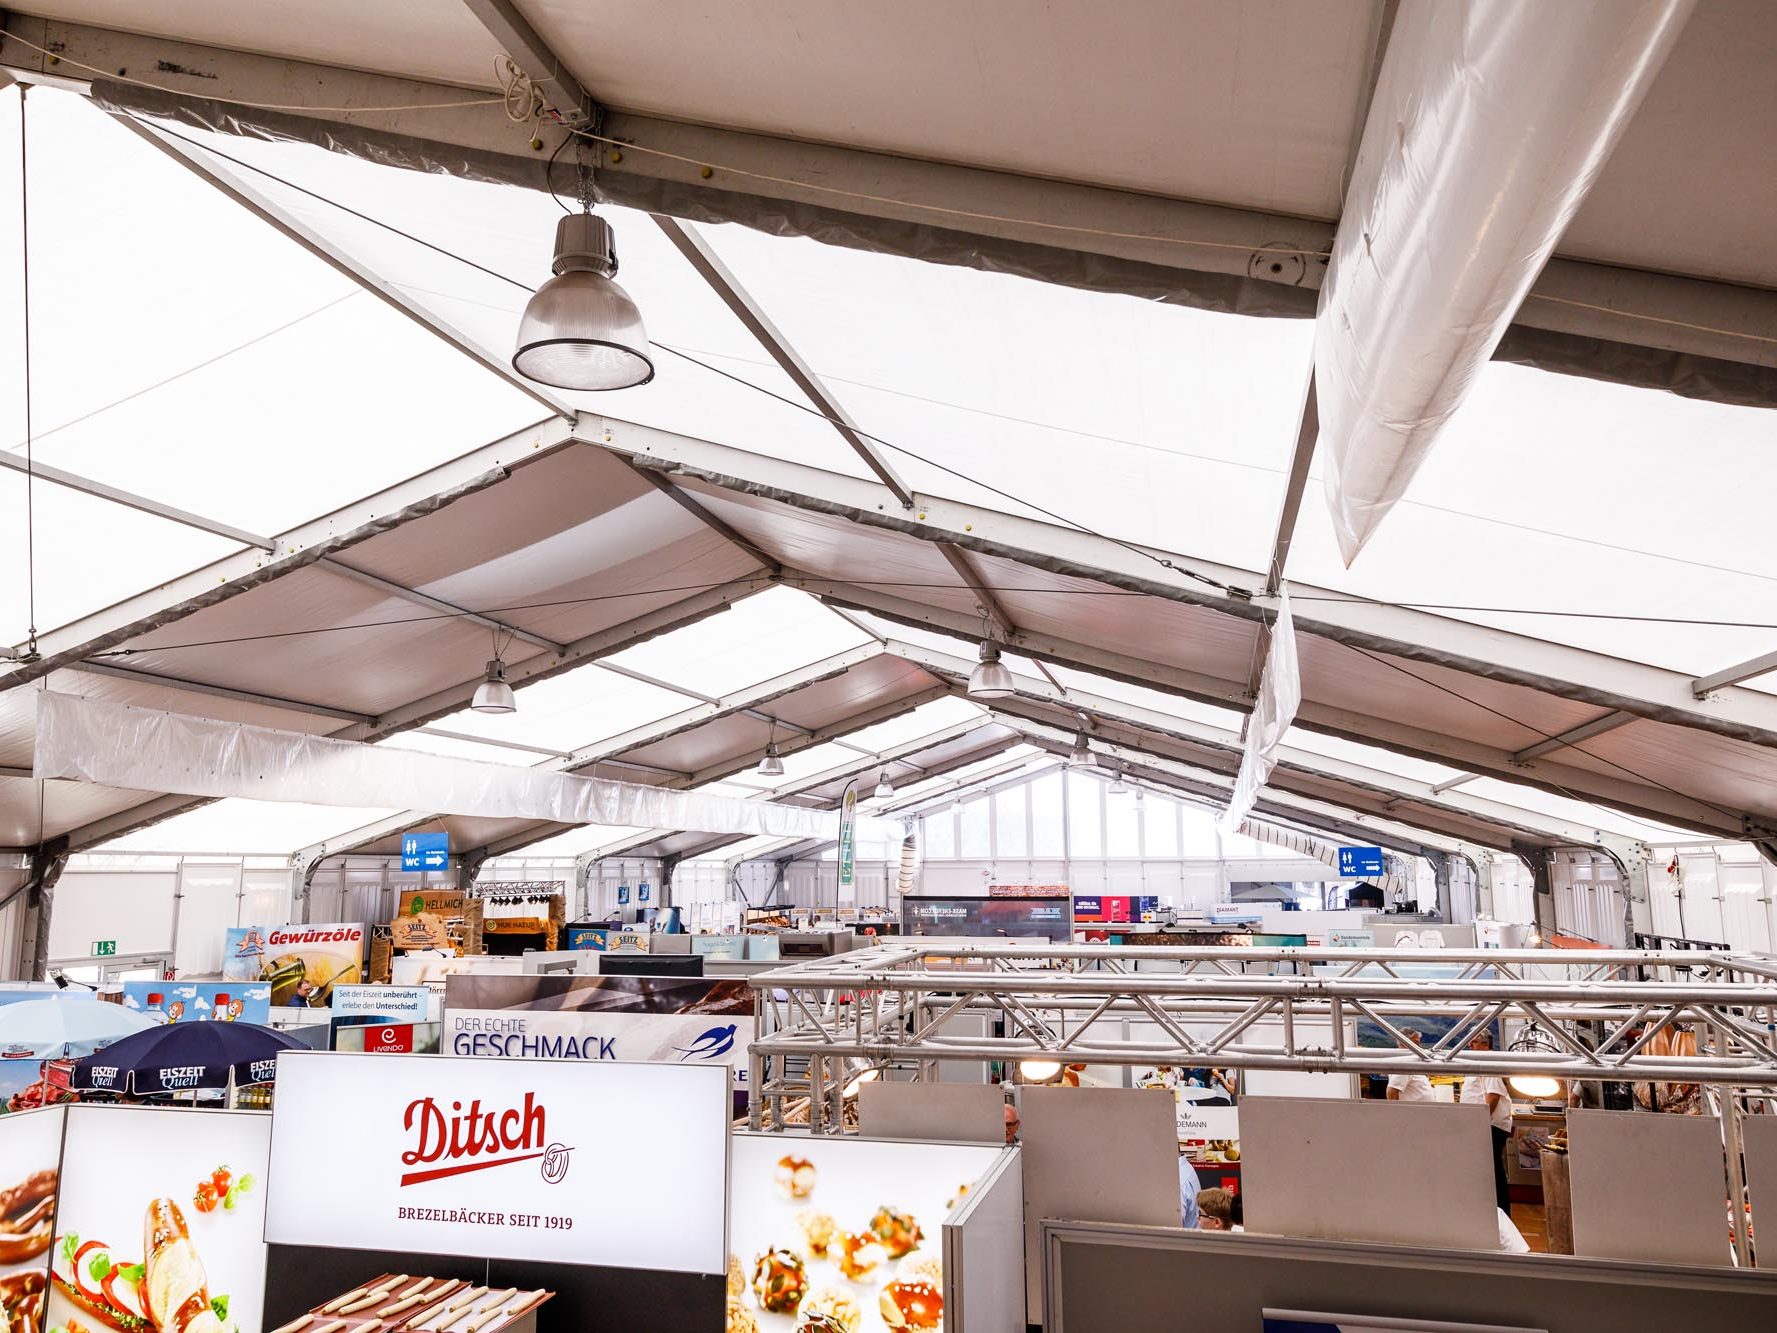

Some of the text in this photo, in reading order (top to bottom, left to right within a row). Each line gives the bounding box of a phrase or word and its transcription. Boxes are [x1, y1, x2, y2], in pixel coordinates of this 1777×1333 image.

[406, 858, 420, 866] WC
[426, 898, 463, 910] HELLMICH
[408, 924, 426, 932] SEITZ
[268, 928, 362, 945] Gewürzöle
[619, 935, 638, 944] SEITZ
[455, 1018, 526, 1032] DER ECHTE
[454, 1033, 616, 1060] GESCHMACK
[92, 1066, 119, 1078] EISZEIT
[160, 1066, 206, 1080] EISZEIT
[162, 1074, 199, 1089] Quell
[402, 1092, 545, 1166] Ditsch
[398, 1207, 573, 1230] BREZELBÄCKER SEIT 1919
